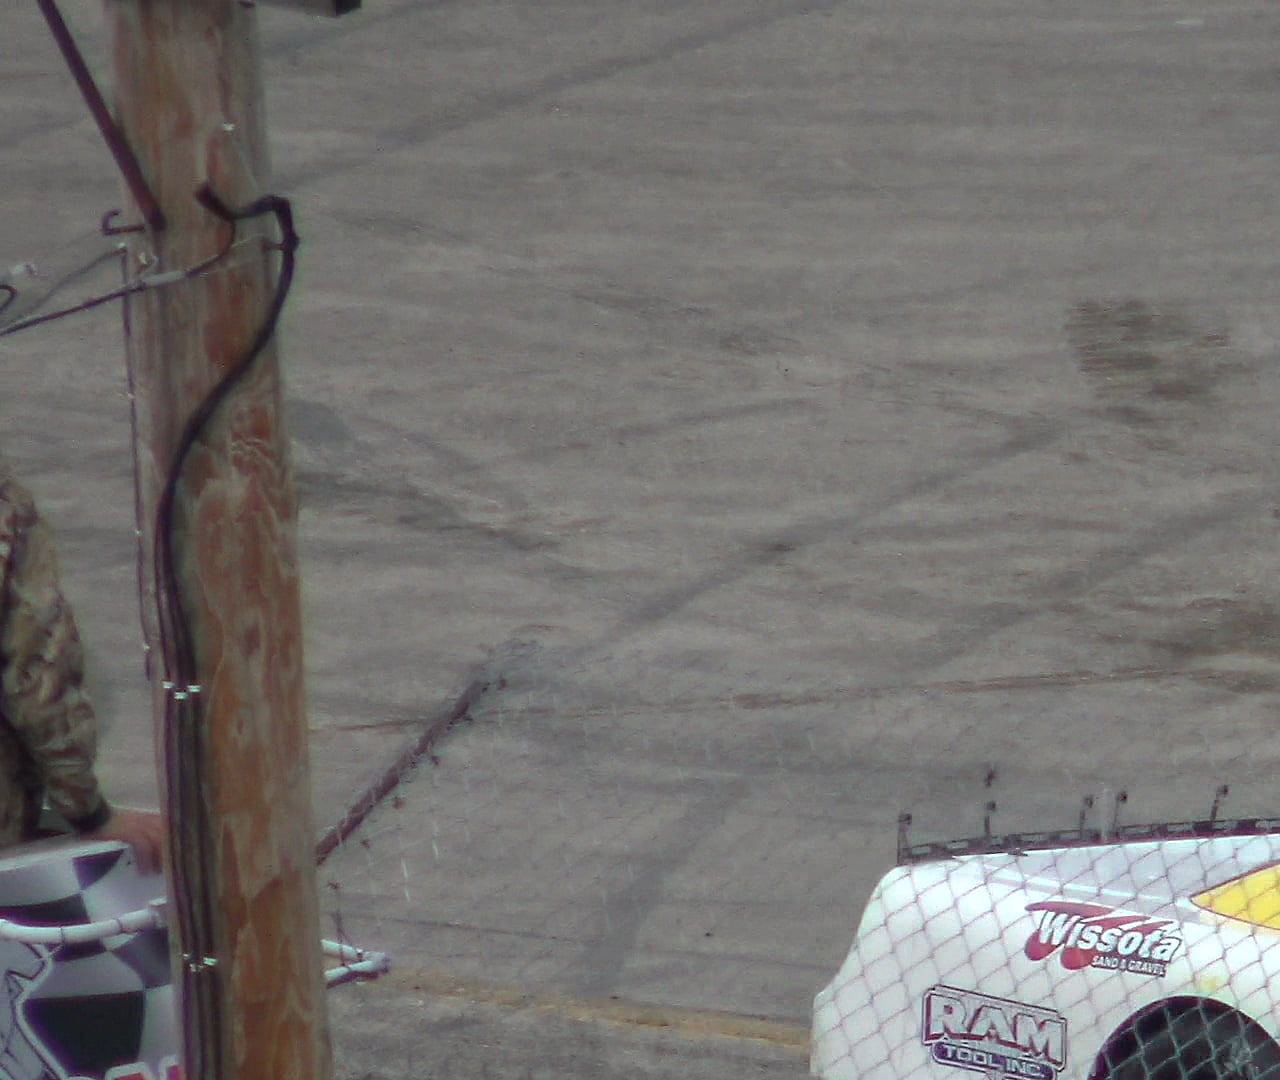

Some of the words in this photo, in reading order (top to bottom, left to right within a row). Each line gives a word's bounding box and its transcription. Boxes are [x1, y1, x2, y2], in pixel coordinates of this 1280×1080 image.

[1039, 910, 1182, 962] Wissota
[1092, 955, 1119, 970] SAND
[1127, 960, 1167, 977] GRAVEL
[926, 993, 1063, 1066] RAM
[944, 1045, 1003, 1067] TOOL
